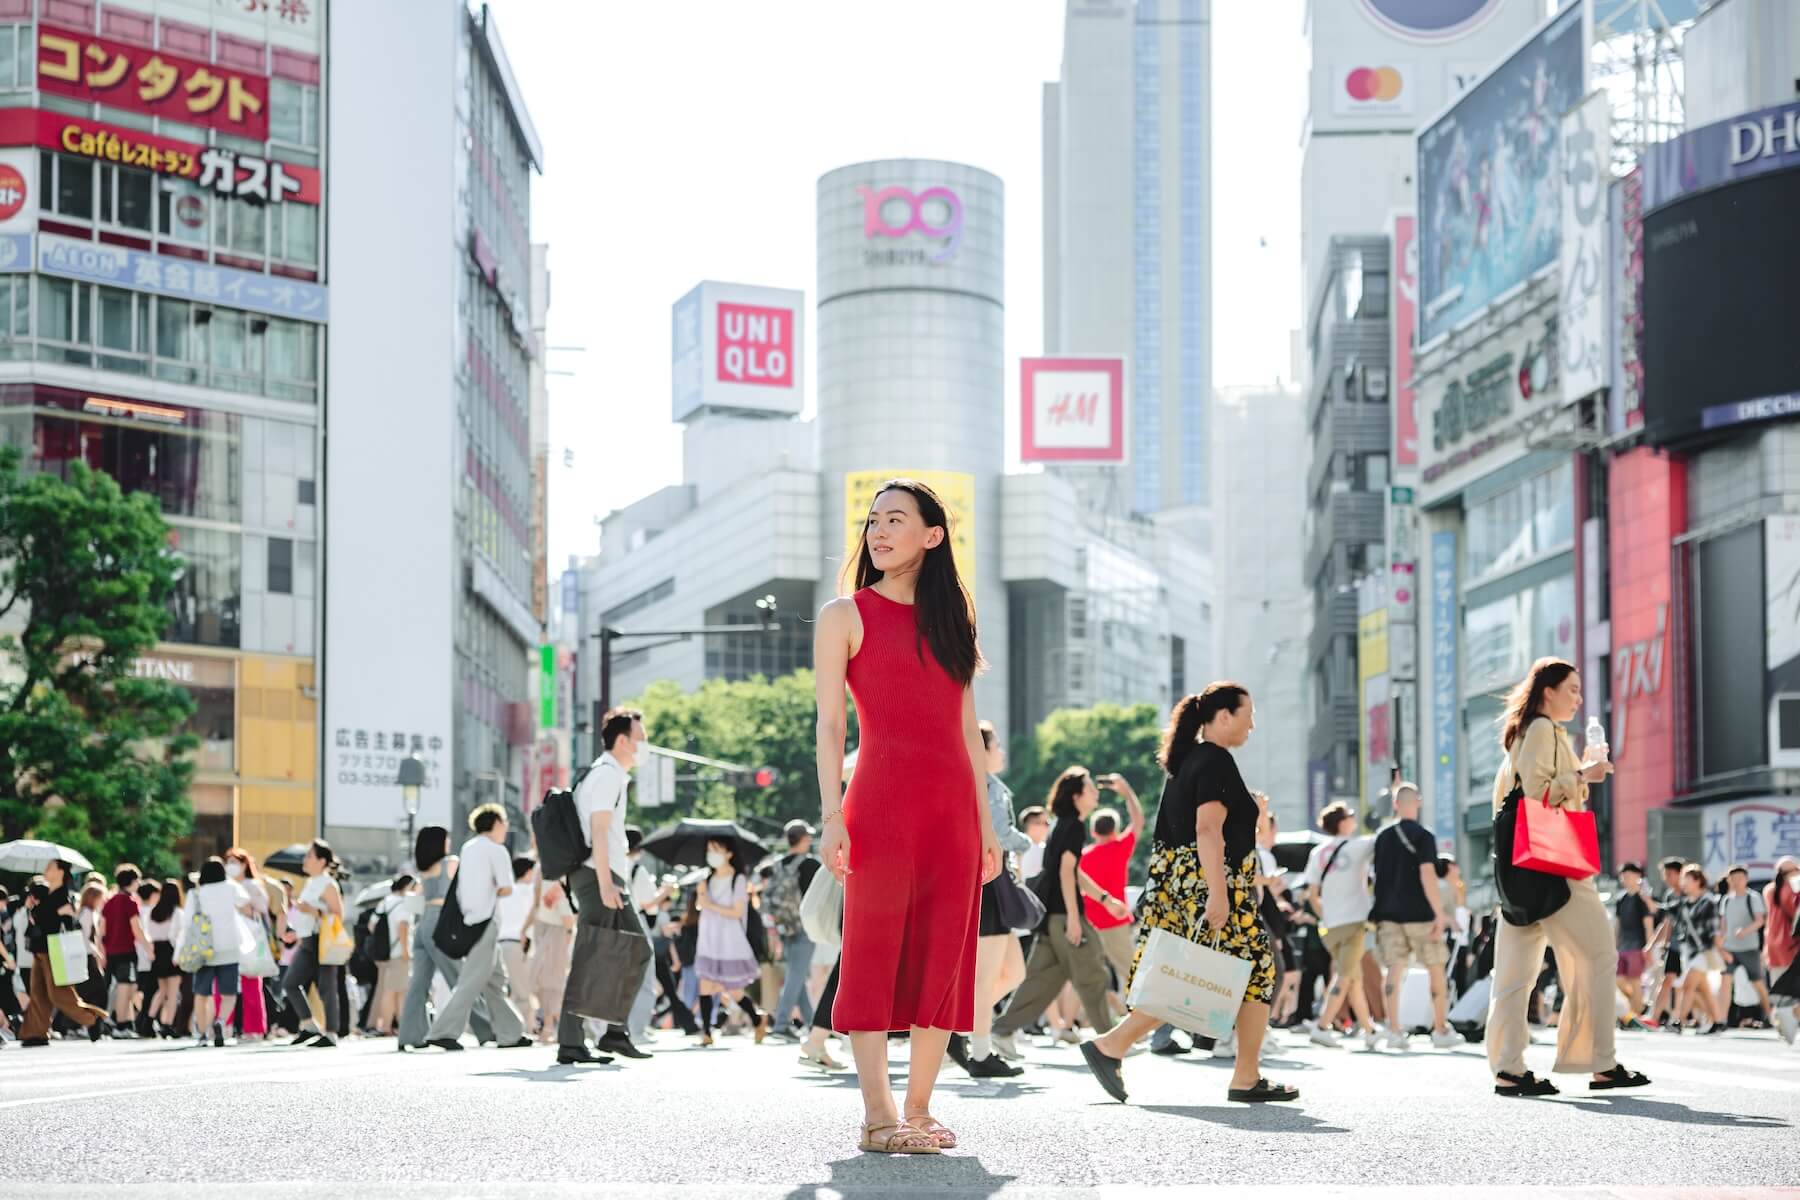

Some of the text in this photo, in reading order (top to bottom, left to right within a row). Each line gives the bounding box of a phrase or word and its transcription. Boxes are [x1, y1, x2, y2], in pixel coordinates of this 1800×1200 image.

[39, 33, 261, 121] コンタクト
[1729, 110, 1800, 166] DH
[201, 150, 300, 202] ガスト
[855, 184, 962, 263] 109
[724, 311, 782, 345] UNI
[724, 345, 786, 379] QLO
[1160, 964, 1233, 999] CALZEDONIA
